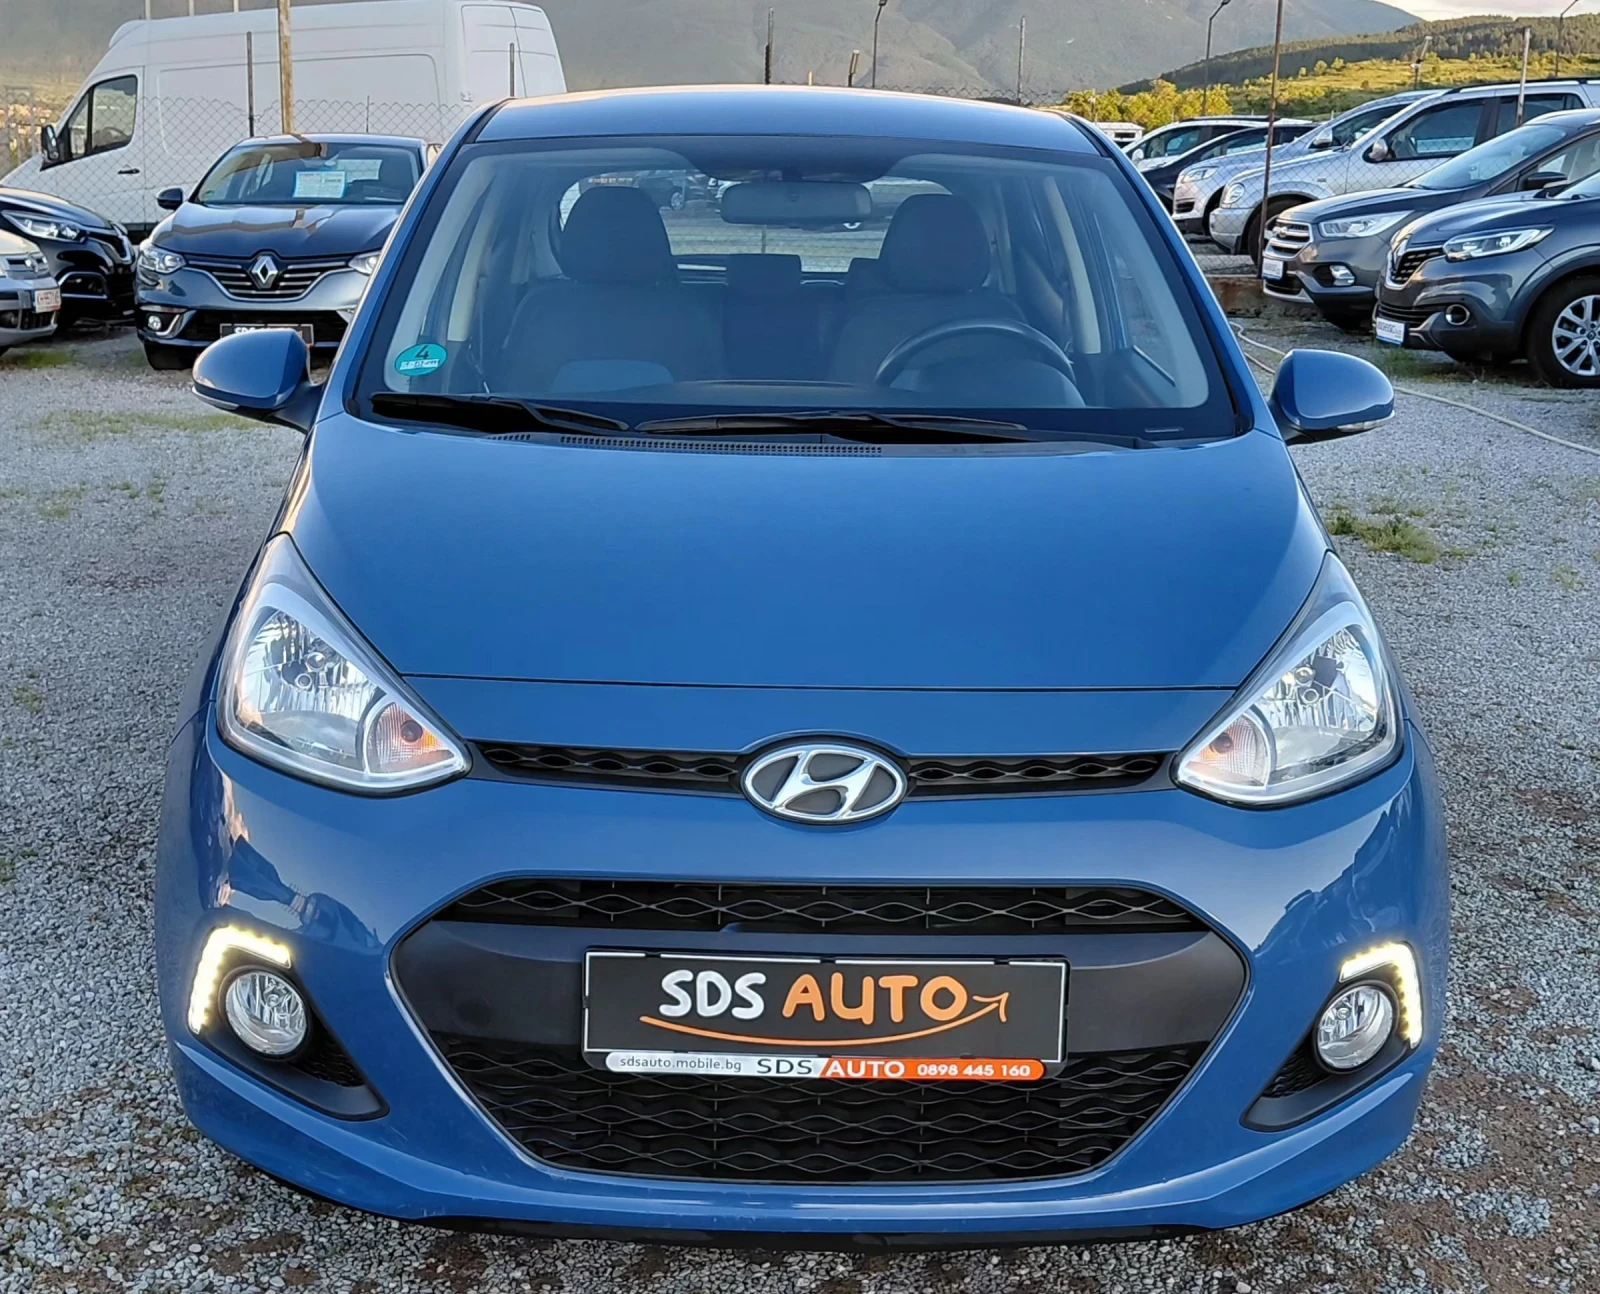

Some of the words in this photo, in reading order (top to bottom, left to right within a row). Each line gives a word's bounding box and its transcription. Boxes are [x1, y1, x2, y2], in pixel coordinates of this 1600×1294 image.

[414, 344, 430, 360] 4
[658, 969, 767, 1020] SDS
[782, 972, 968, 1025] AUTO
[619, 1057, 742, 1073] sdsauto.mobile.bg
[756, 1058, 813, 1075] SDS
[825, 1060, 906, 1078] AUTO
[917, 1063, 958, 1076] 0898
[962, 1064, 995, 1077] 445
[1001, 1064, 1031, 1077] 160
